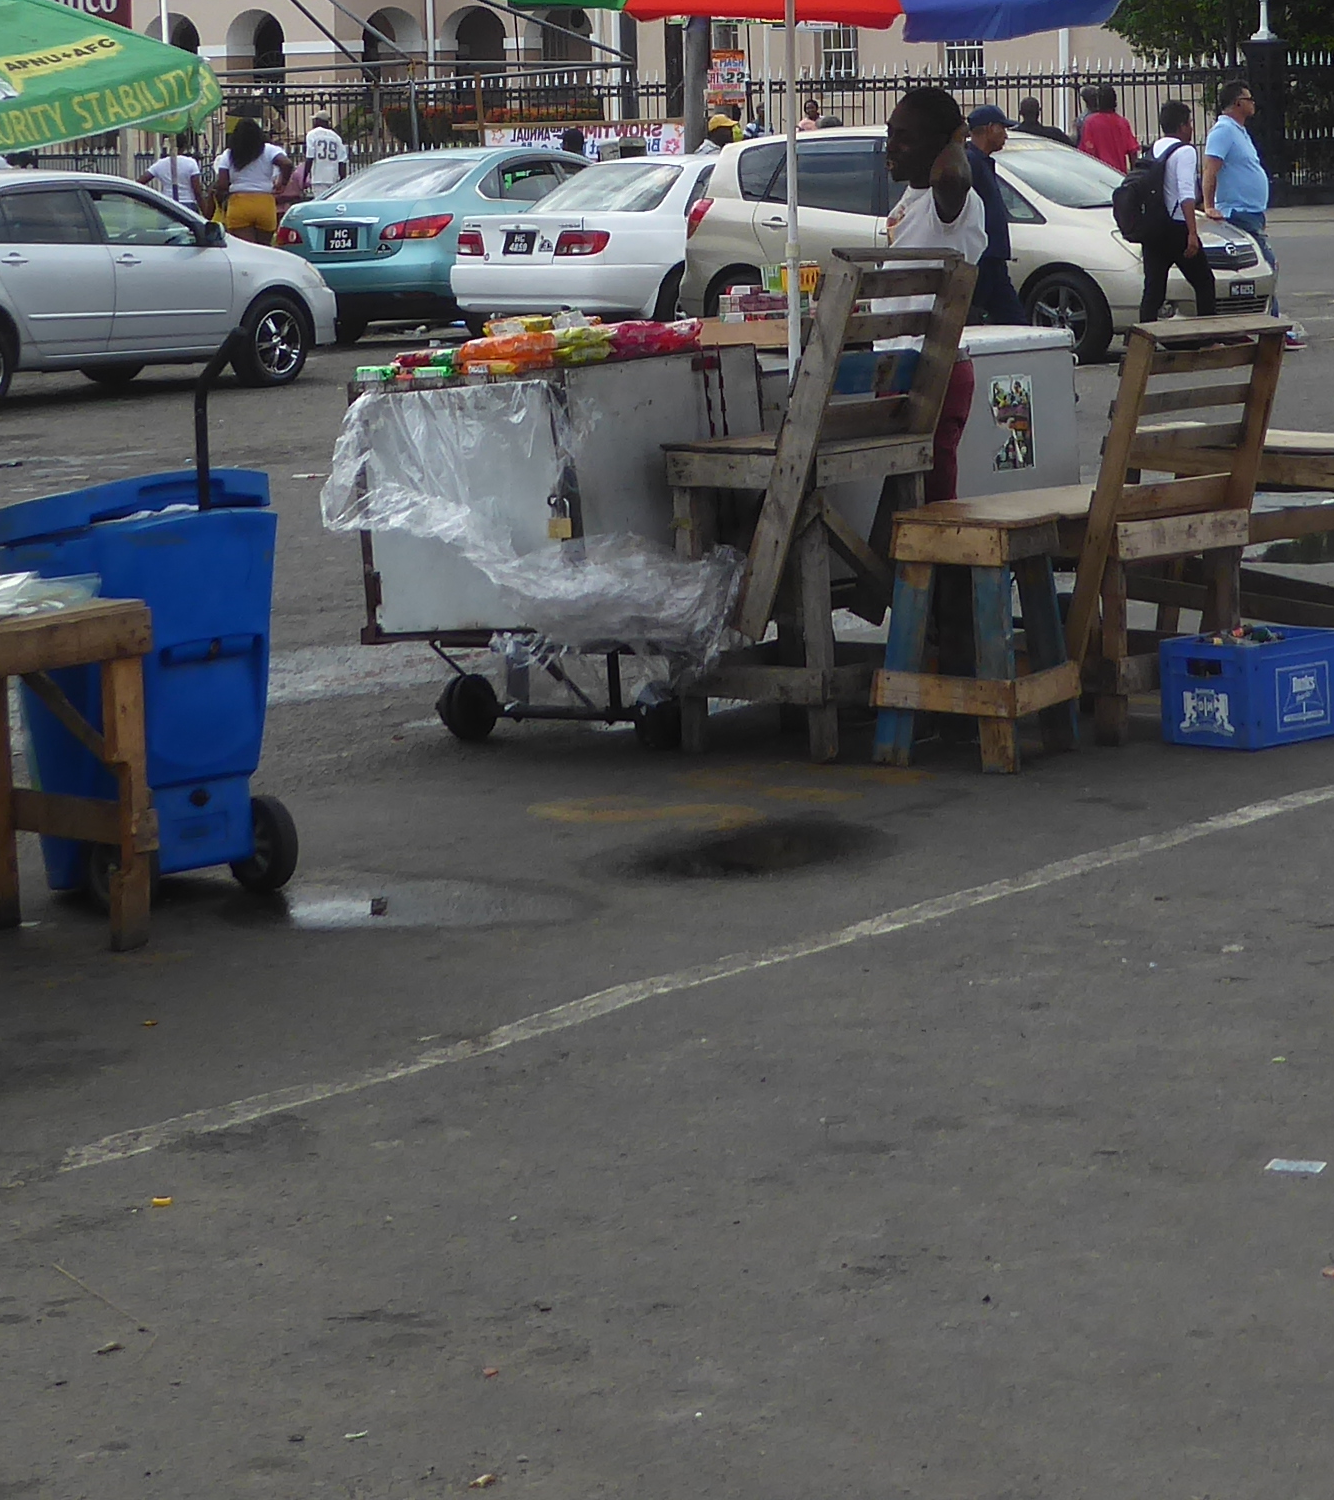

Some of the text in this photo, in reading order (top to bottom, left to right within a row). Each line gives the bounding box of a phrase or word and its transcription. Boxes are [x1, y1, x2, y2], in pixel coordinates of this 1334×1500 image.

[5, 37, 116, 71] APNU+AFC
[71, 65, 195, 129] STABILITY
[317, 140, 338, 161] 39
[329, 239, 352, 249] 7034
[333, 229, 348, 239] HC
